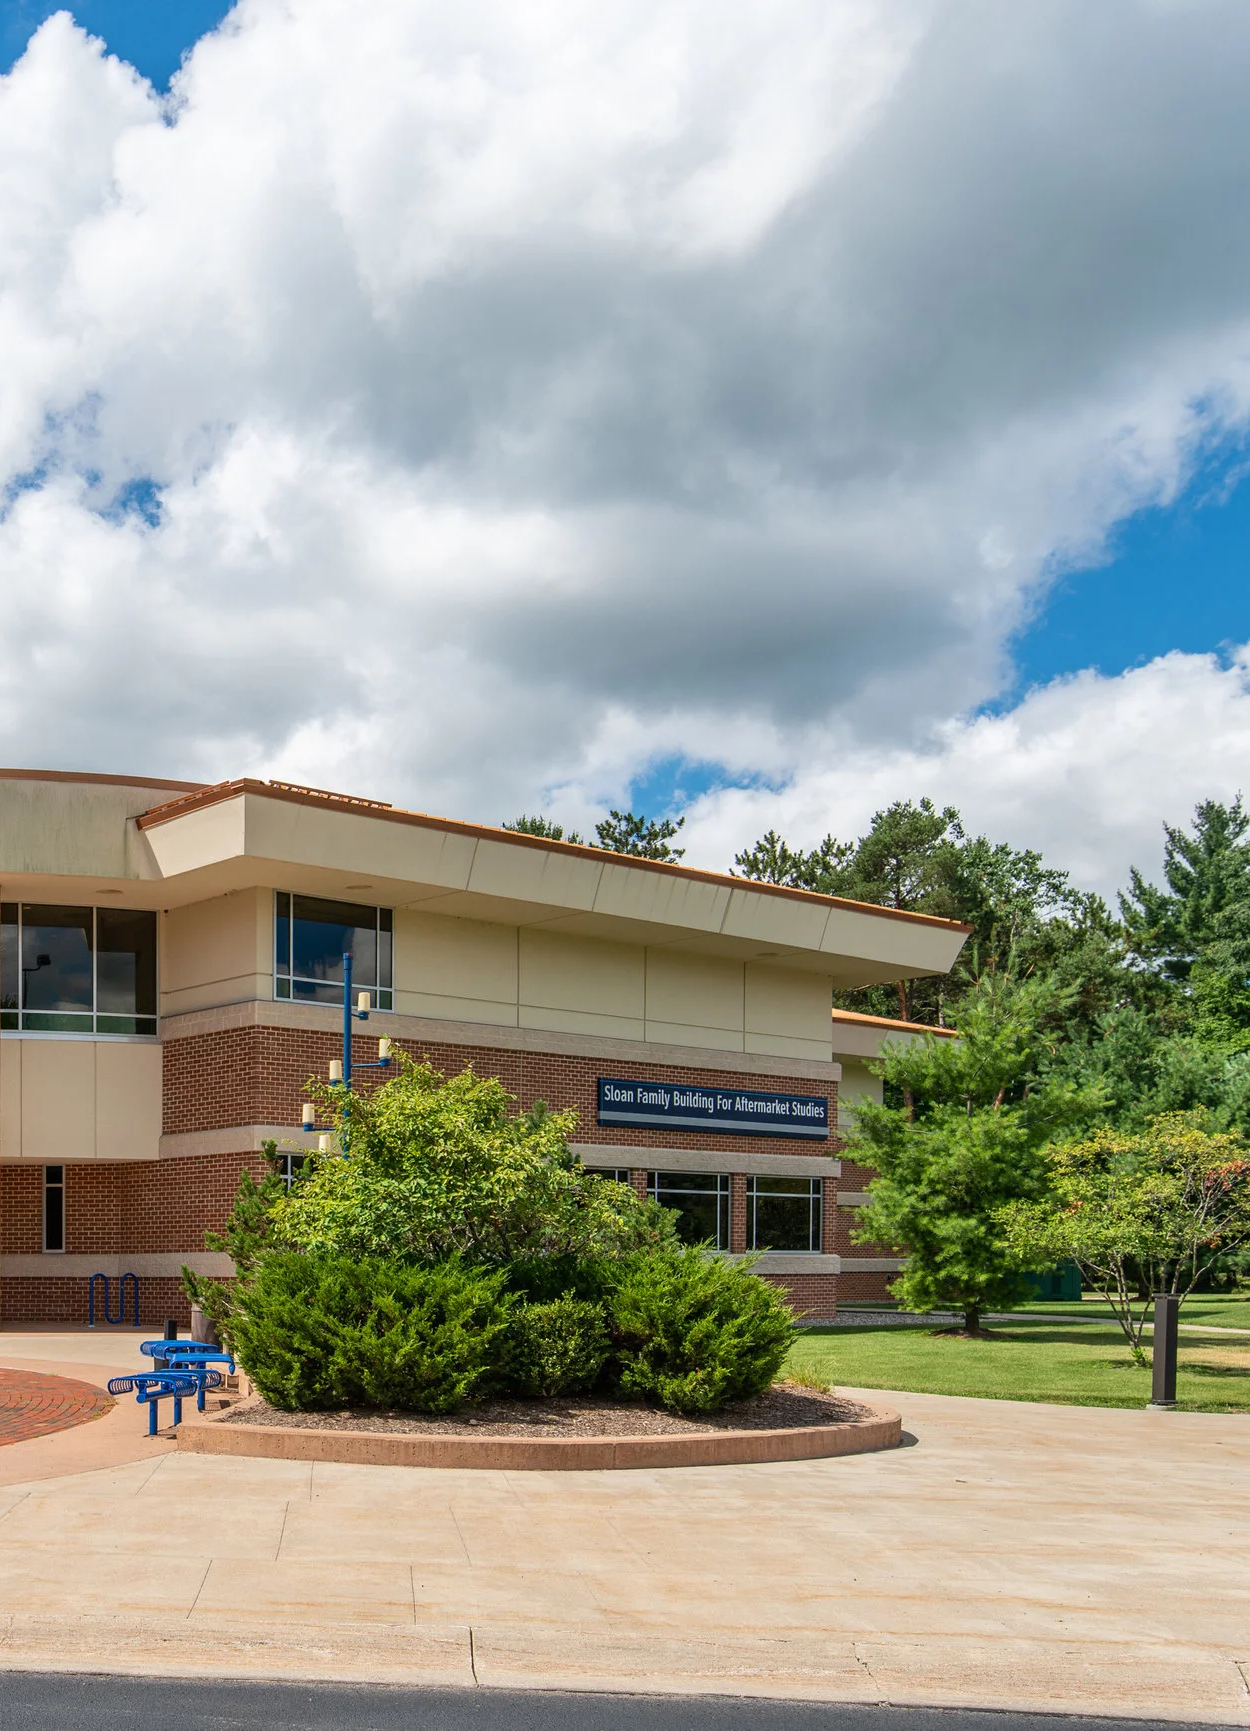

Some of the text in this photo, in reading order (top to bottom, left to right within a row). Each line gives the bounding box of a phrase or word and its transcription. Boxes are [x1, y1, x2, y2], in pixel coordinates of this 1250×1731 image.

[604, 1085, 825, 1118] Sloan Family Building For Aftermarket Studies
